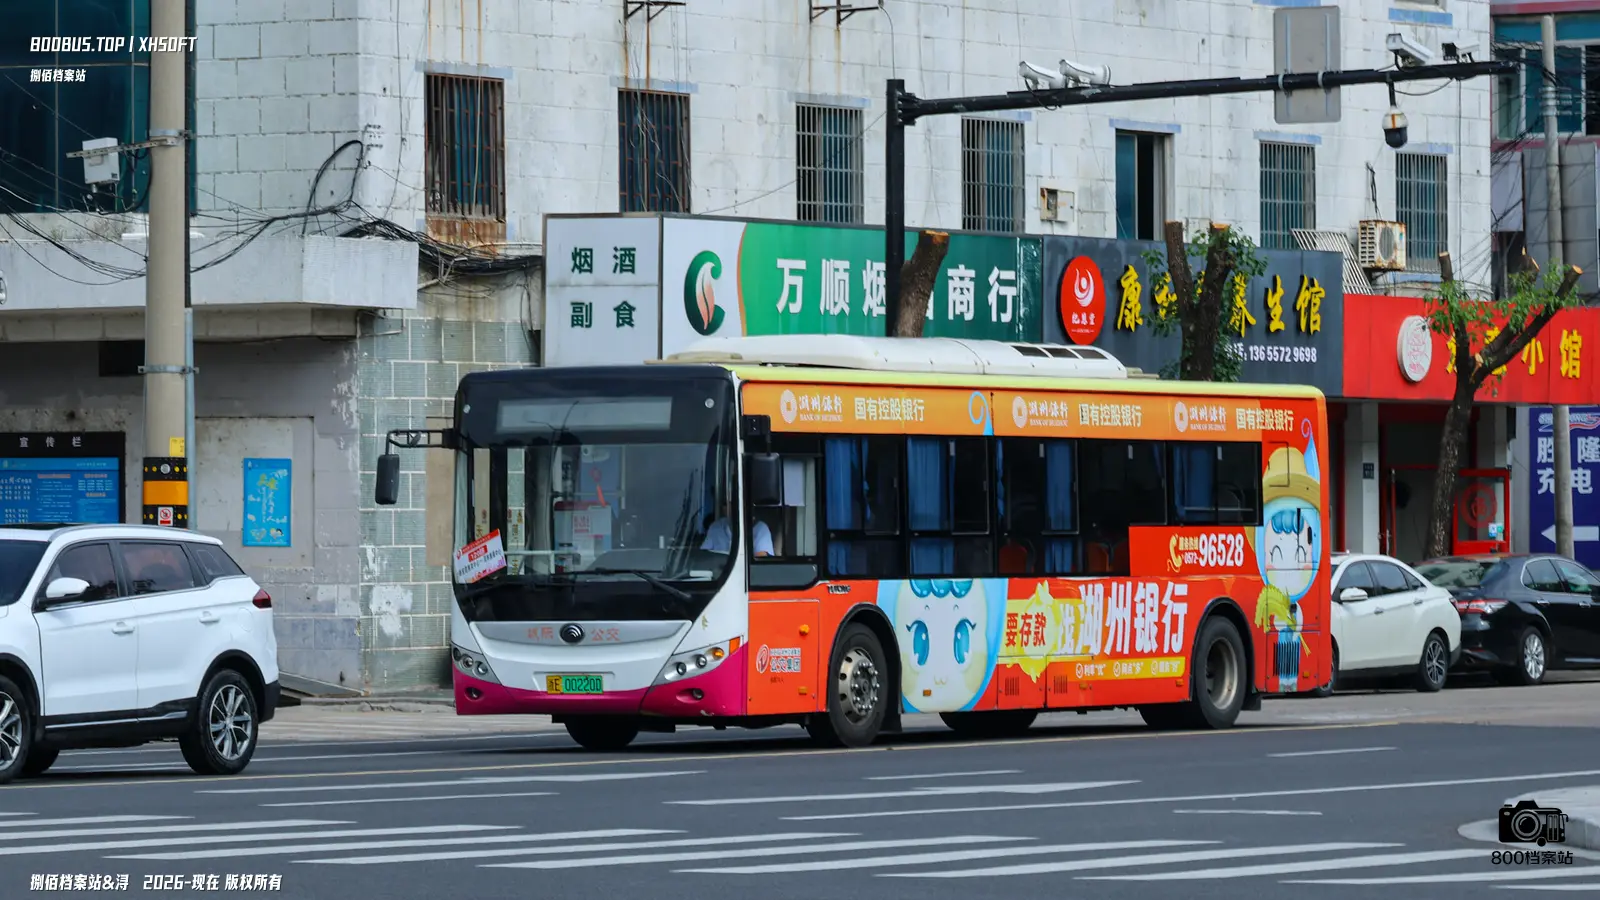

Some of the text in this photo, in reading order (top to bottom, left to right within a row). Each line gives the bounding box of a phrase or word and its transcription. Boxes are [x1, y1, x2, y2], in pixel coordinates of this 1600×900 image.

[571, 246, 636, 274] 烟酒
[776, 258, 1017, 323] 万顺烟商行
[570, 300, 636, 328] 副食
[1249, 345, 1265, 361] 136
[1267, 346, 1291, 362] 5572
[1293, 347, 1317, 363] 9698
[854, 397, 925, 421] 国有控股银行
[1079, 403, 1142, 427] 国有控股银行
[1236, 407, 1294, 431] 国有控股银行
[19, 436, 81, 447] 宣传栏
[1537, 467, 1593, 495] 充电
[1199, 533, 1244, 567] 96528
[591, 628, 621, 642] 公交
[1005, 612, 1047, 648] 要存款
[770, 656, 801, 672] 公交集团
